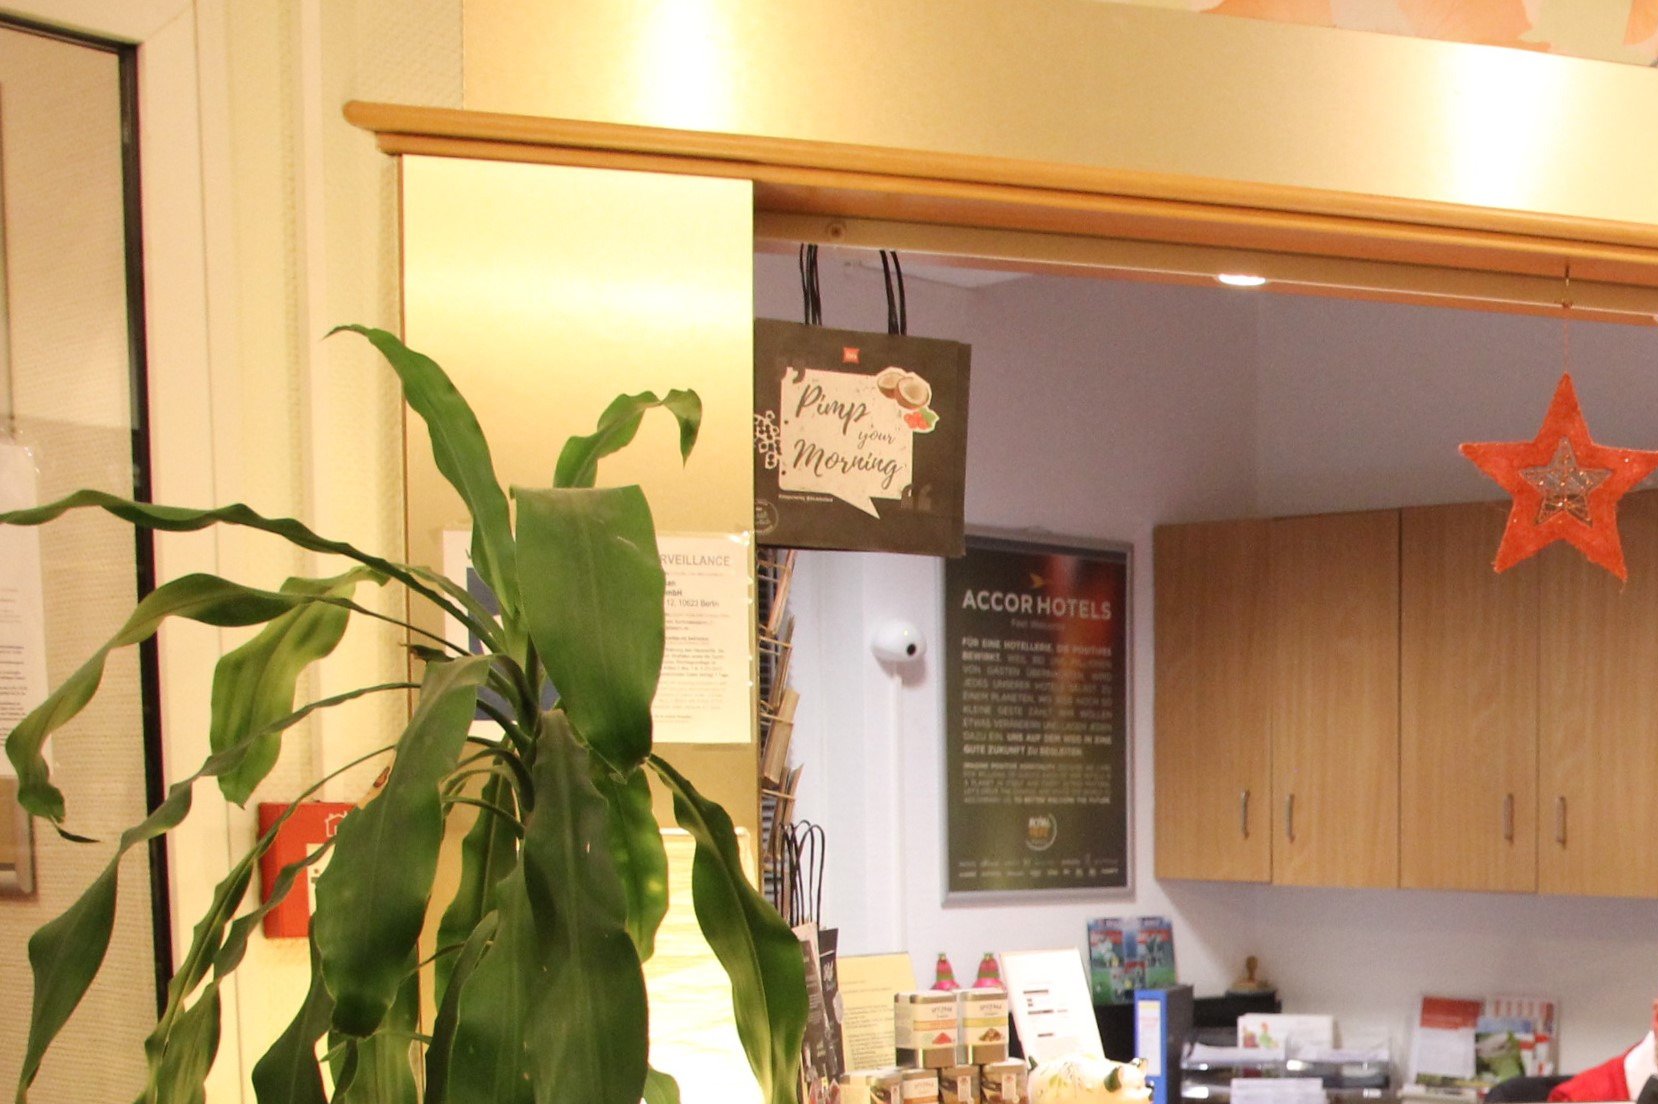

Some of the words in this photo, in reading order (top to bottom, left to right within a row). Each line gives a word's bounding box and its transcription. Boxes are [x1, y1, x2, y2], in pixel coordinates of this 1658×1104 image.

[796, 384, 871, 436] Pimp
[858, 430, 895, 450] your
[793, 439, 900, 490] Morning
[660, 554, 731, 567] RVEILLANCE
